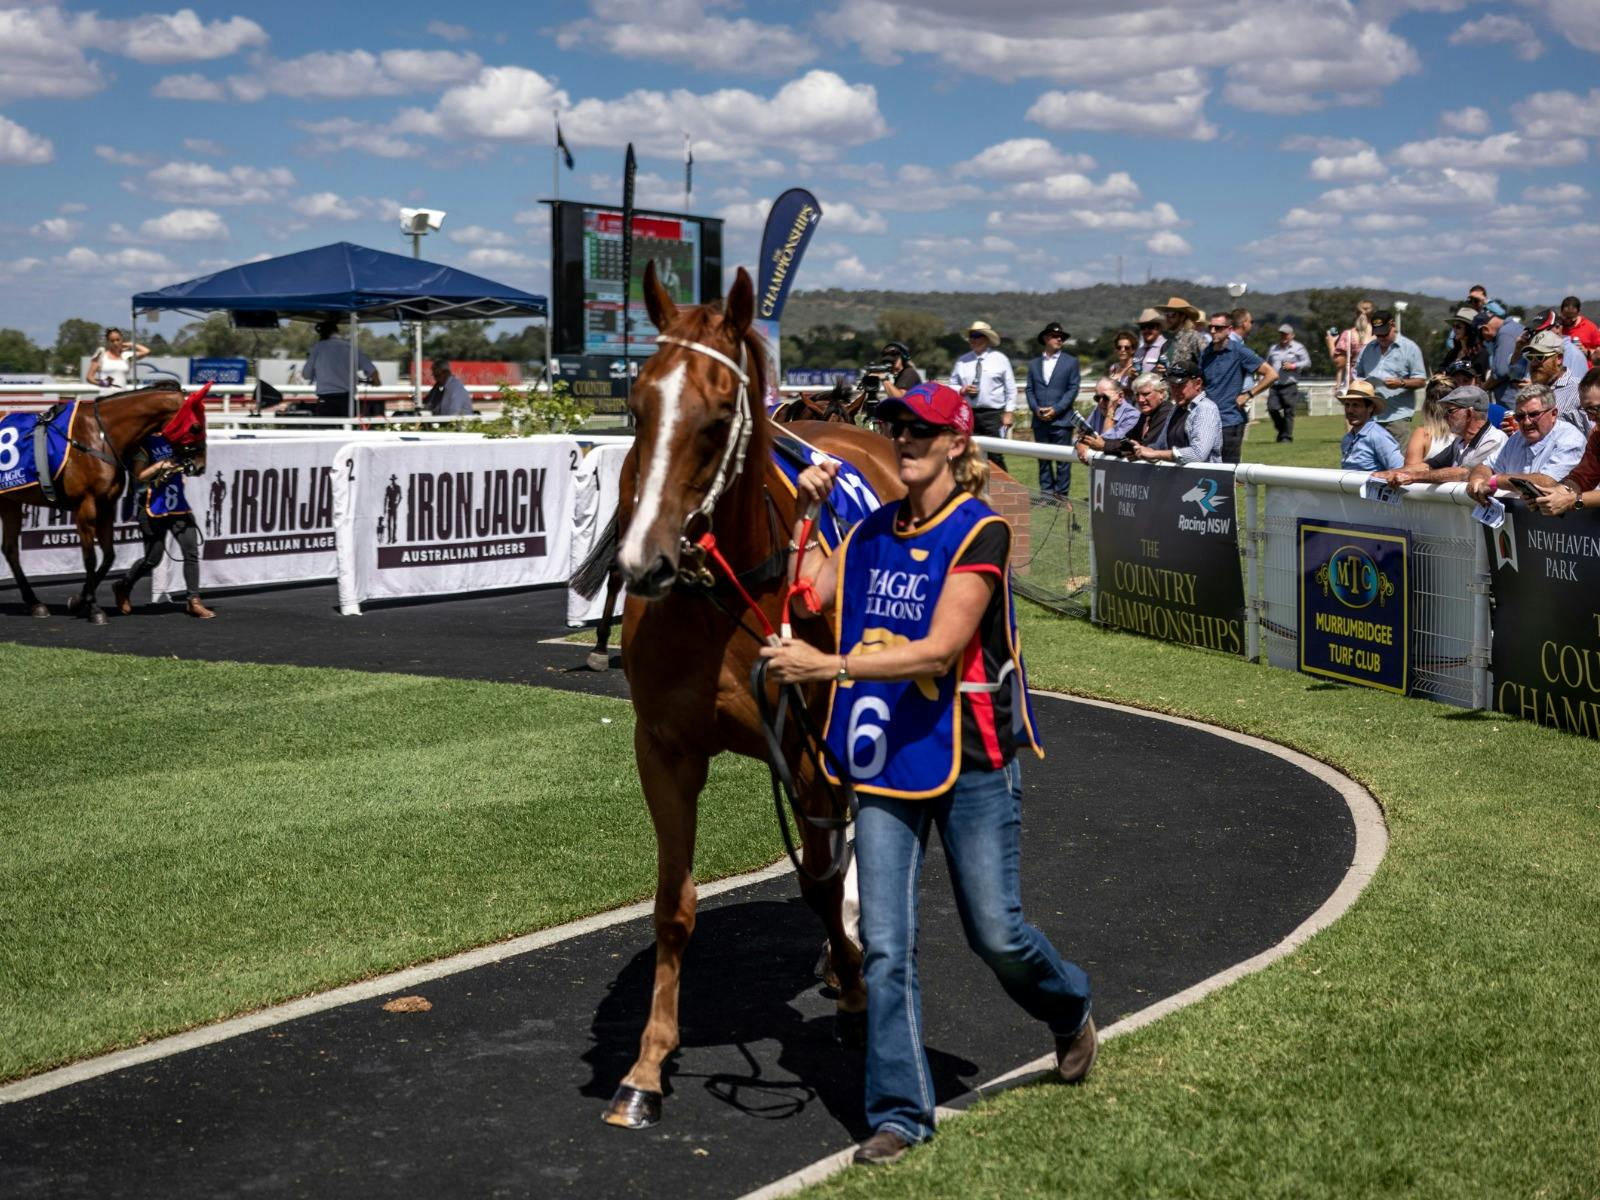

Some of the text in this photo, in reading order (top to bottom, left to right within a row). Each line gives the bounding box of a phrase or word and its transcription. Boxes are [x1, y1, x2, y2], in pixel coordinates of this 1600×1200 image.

[761, 204, 813, 317] CHAMPIONSHIPS
[0, 427, 20, 471] 8
[569, 449, 579, 471] 2
[346, 458, 355, 482] 2
[592, 466, 600, 491] 1
[165, 484, 179, 511] 8
[1110, 482, 1150, 500] NEWHAVEN
[1118, 501, 1136, 518] PARK
[1178, 514, 1231, 535] Racing NSW
[225, 538, 301, 555] AUSTRALIAN
[401, 542, 526, 563] AUSTRALIAN LAGERS
[1141, 538, 1160, 559] THE
[1527, 529, 1600, 559] NEWHAVEN
[1114, 560, 1197, 606] COUNTRY
[1336, 556, 1372, 594] MTC
[1546, 558, 1578, 582] PARK
[1099, 590, 1241, 654] CHAMPIONSHIPS
[1316, 612, 1393, 646] MURRUMBIDGEE
[1328, 643, 1381, 673] TURF CLUB
[847, 695, 891, 780] 6
